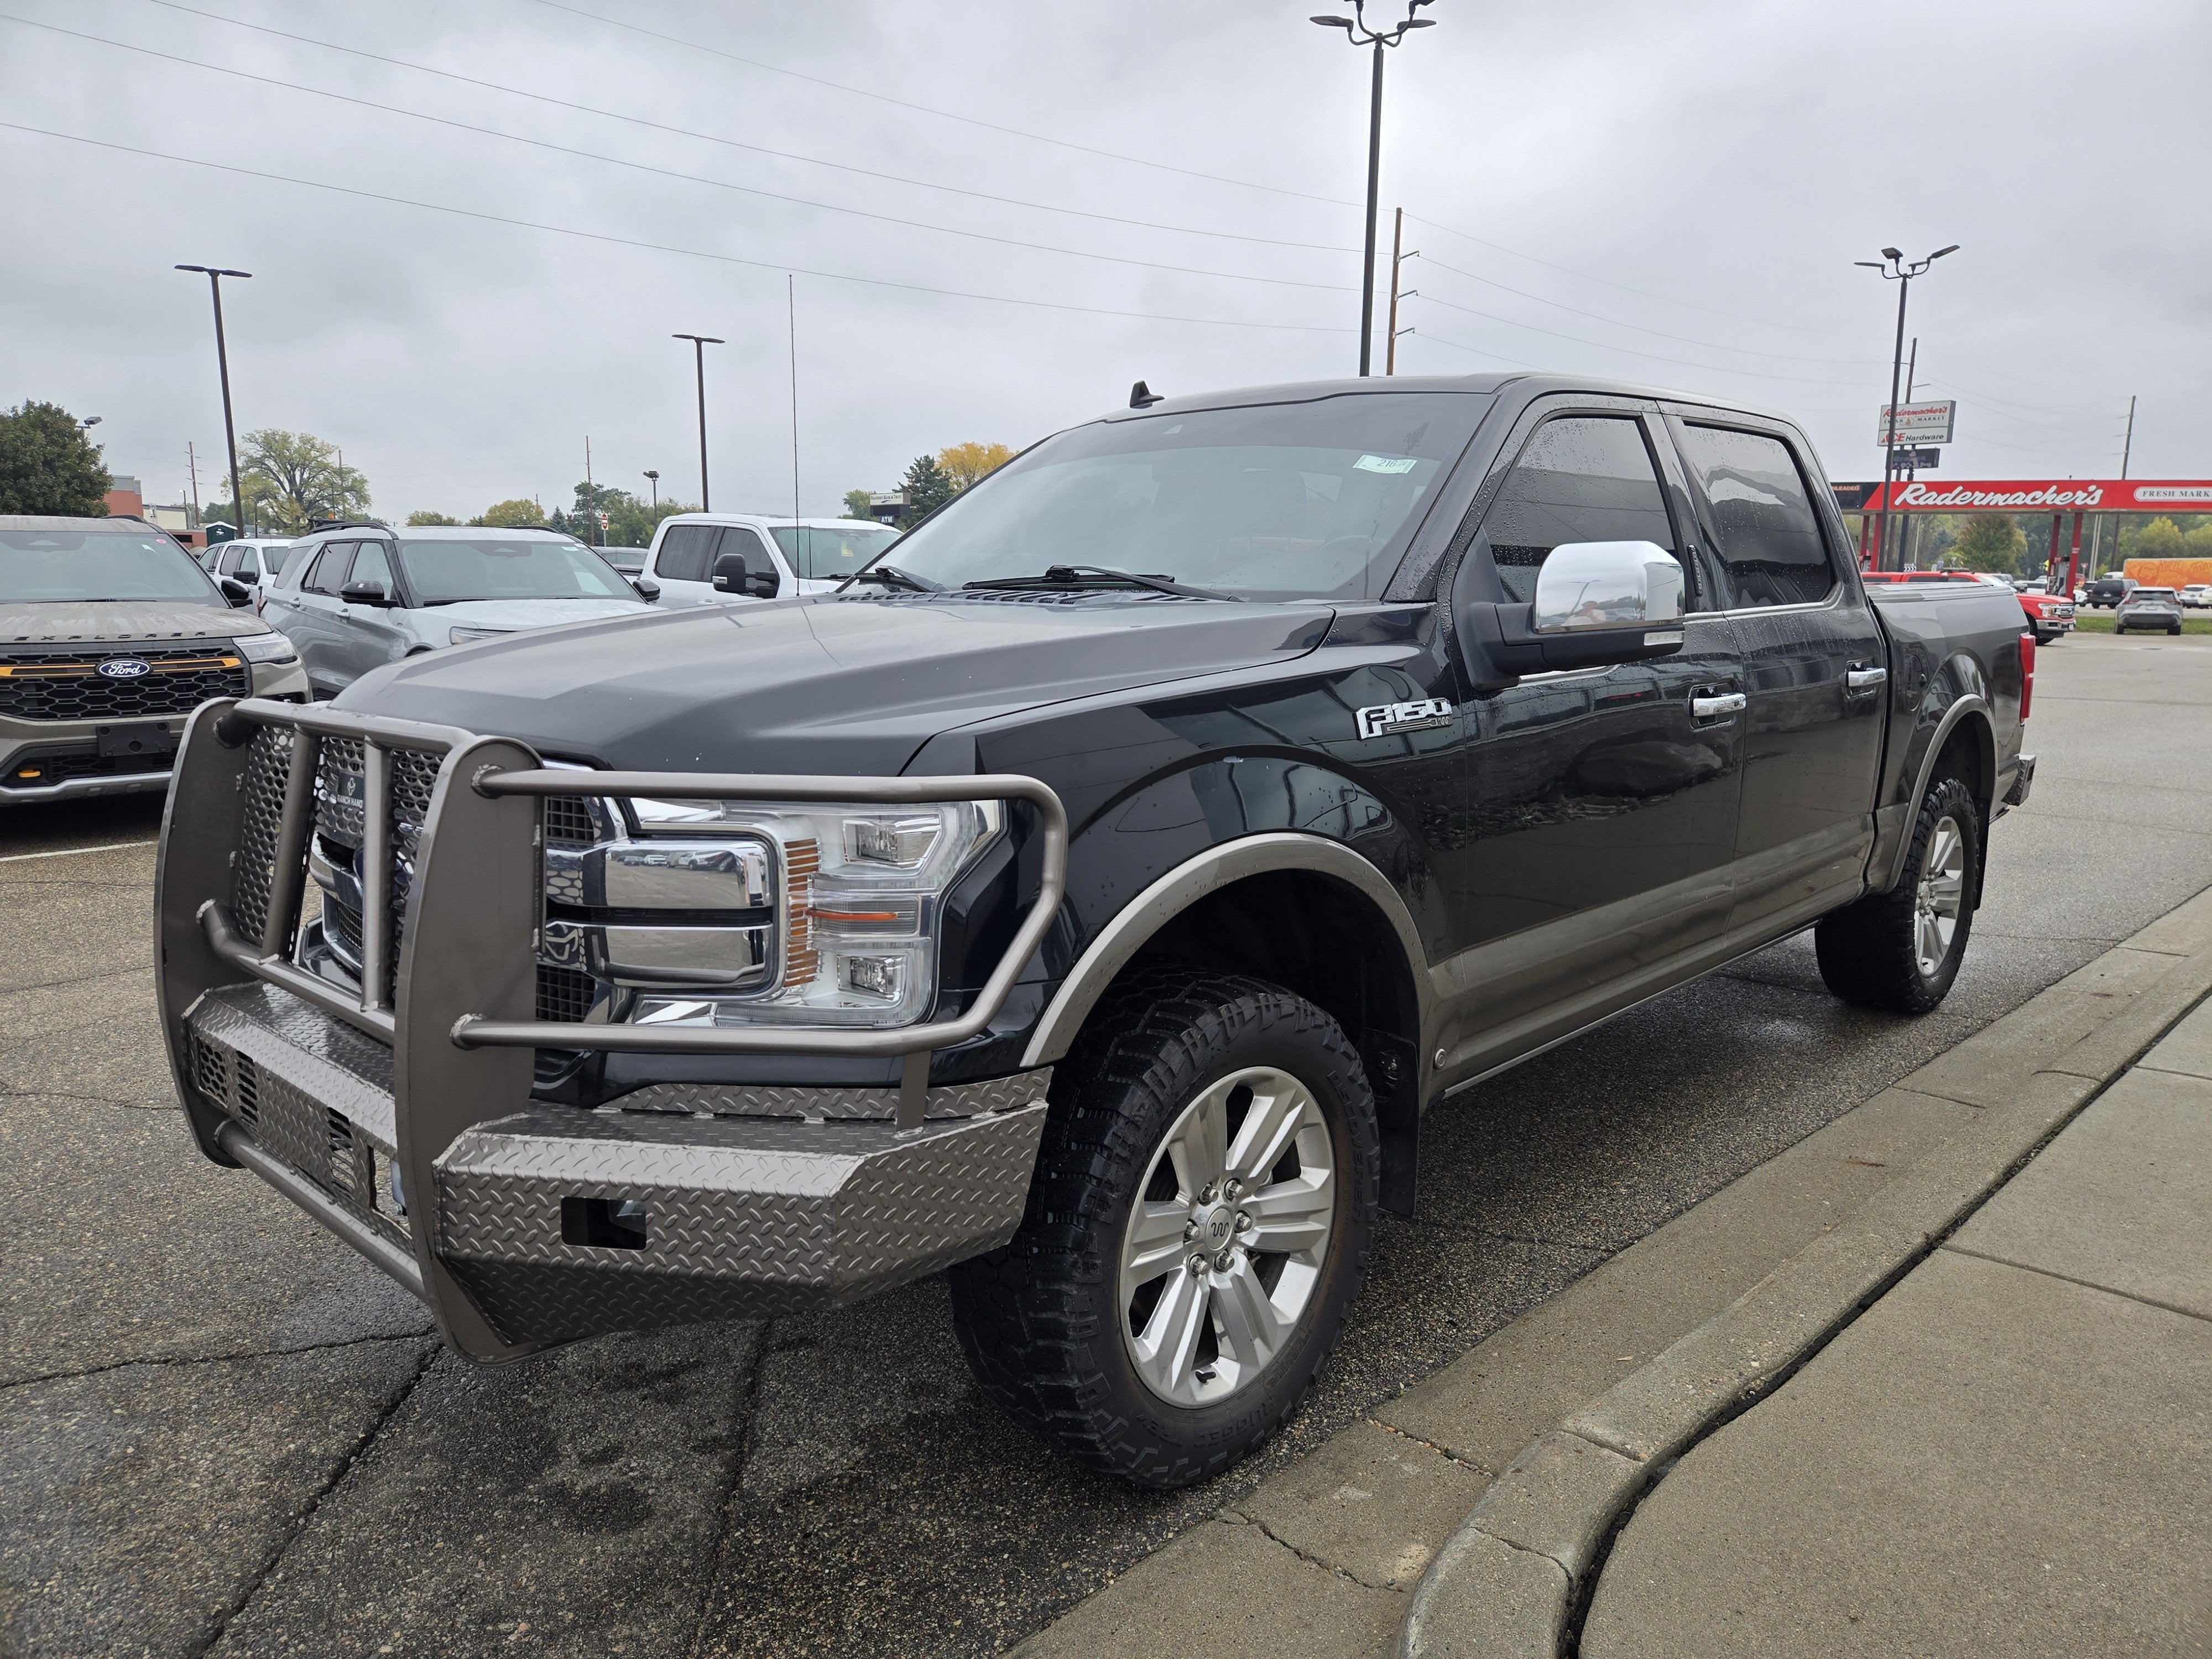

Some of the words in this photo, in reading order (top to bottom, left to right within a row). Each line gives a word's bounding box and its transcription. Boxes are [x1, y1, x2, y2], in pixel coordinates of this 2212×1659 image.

[1882, 406, 1948, 418] Rdermacher's
[1894, 483, 2103, 507] Radermacher's
[14, 631, 206, 641] EXPLORER
[108, 662, 140, 675] Ford
[337, 794, 351, 805] RANCH
[351, 797, 363, 809] HAND
